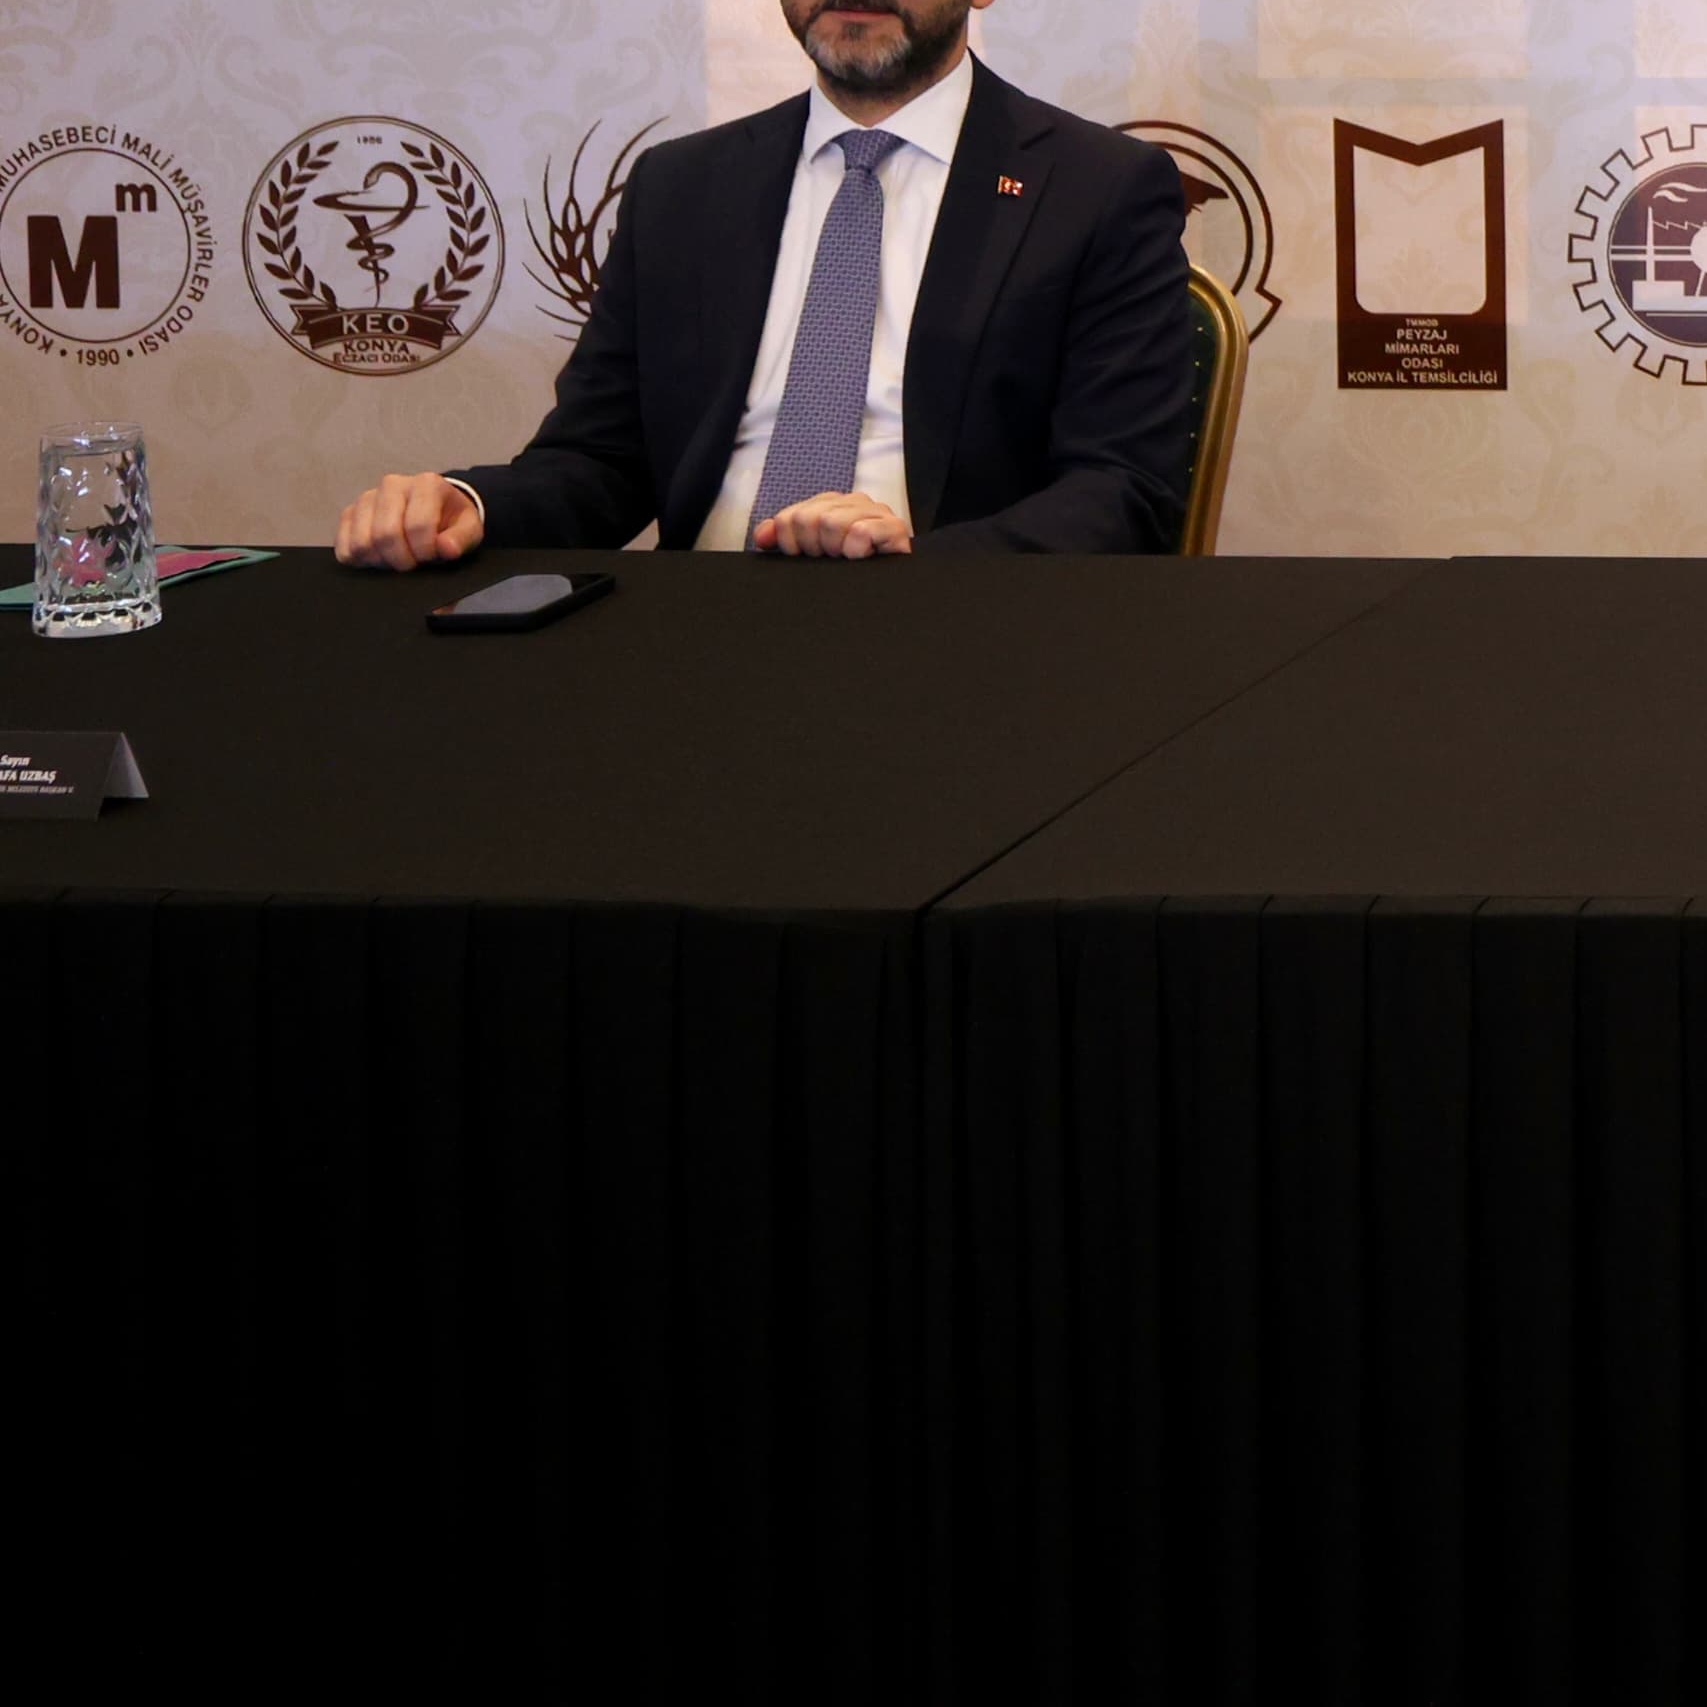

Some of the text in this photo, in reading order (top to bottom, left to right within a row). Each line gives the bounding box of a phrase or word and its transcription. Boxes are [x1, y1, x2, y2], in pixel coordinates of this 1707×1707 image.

[121, 132, 175, 170] MALİ
[168, 167, 217, 303] MÜŞAVİRLER
[138, 304, 194, 356] ODASI
[341, 313, 409, 335] KEO
[1396, 329, 1448, 340] PEYZAJ
[343, 339, 410, 354] KONYA
[1384, 341, 1460, 355] MİMARLARI
[76, 348, 120, 367] 1990
[1401, 357, 1443, 369] ODASI
[1347, 370, 1499, 384] KONYA İL TEMSİLCİLİĞİ
